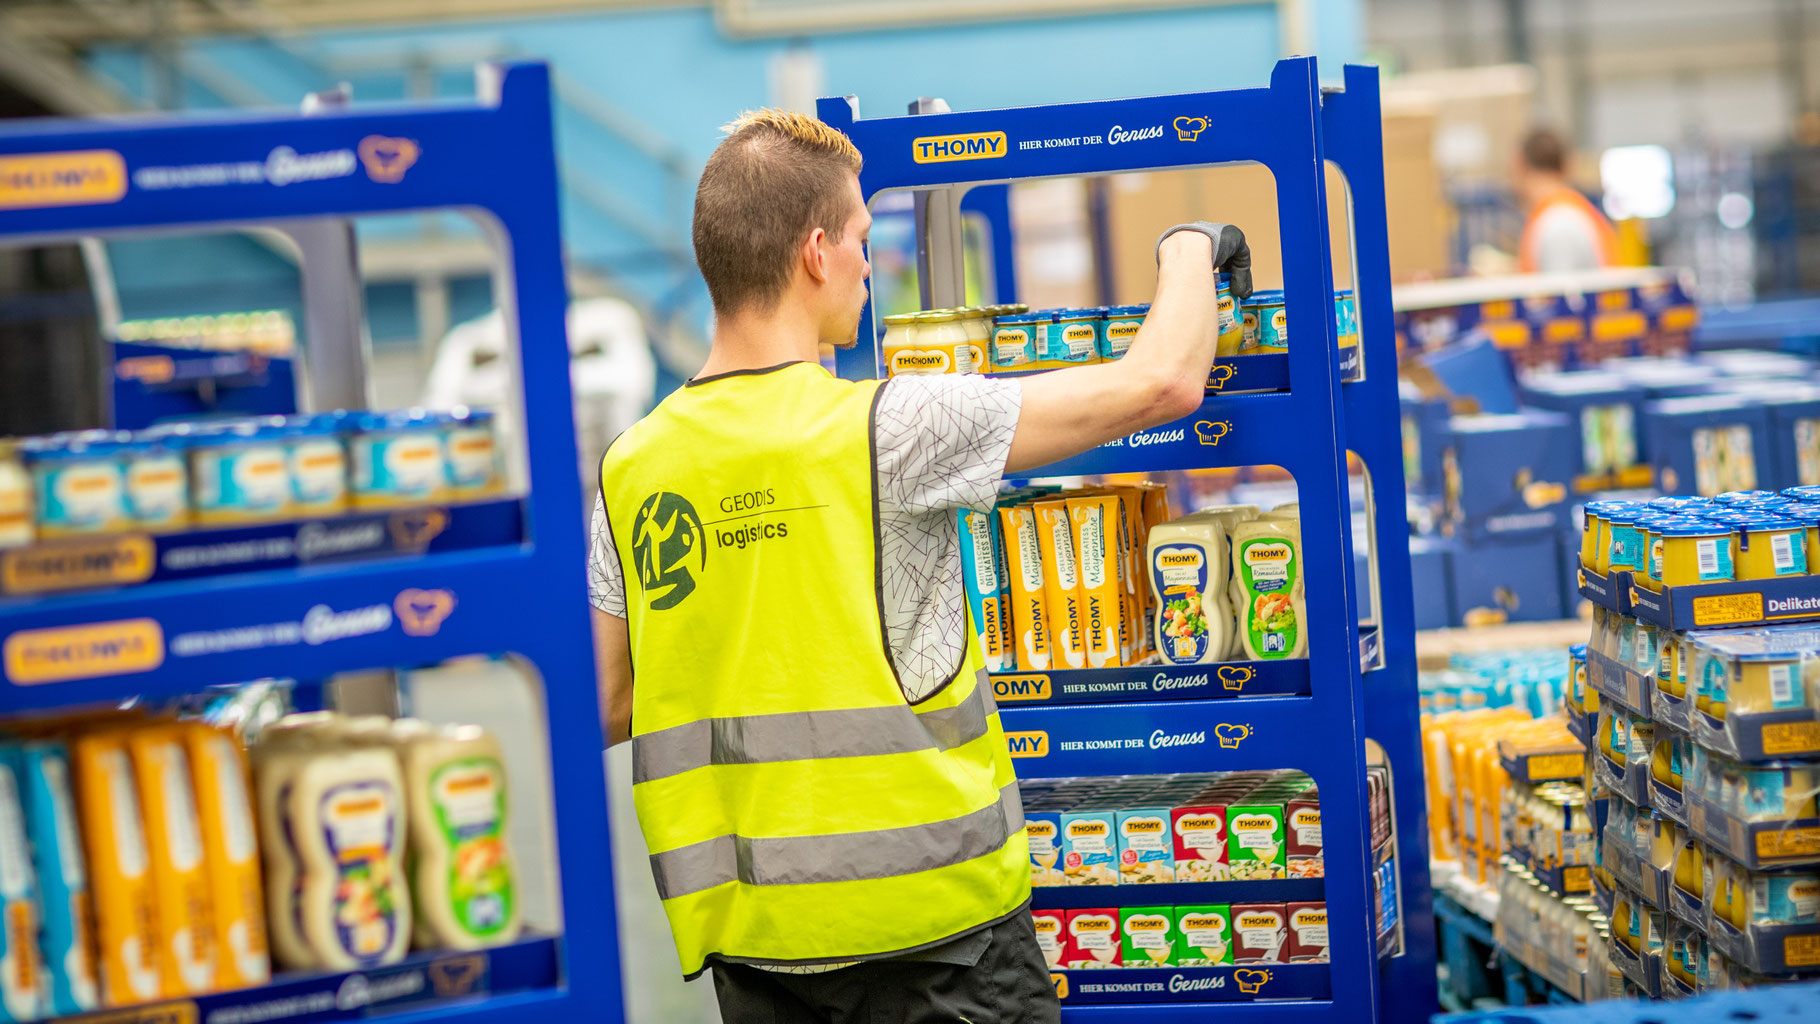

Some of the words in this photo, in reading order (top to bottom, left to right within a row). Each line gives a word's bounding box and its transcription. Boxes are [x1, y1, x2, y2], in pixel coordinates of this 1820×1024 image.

[917, 136, 1002, 158] THOMY
[1019, 139, 1043, 150] HIER
[1044, 137, 1081, 148] KOMMT
[1083, 136, 1103, 145] DER
[1107, 125, 1164, 146] Genuss
[1217, 300, 1232, 309] OMY
[1128, 428, 1185, 448] Genuss
[720, 488, 775, 513] GEODIS
[715, 520, 788, 549] logistics
[1021, 530, 1031, 574] DELIKATESS
[1026, 519, 1041, 586] Mayonnaise
[1055, 528, 1066, 572] DELIKATESS
[1060, 518, 1076, 583] Mayonnaise
[1082, 527, 1091, 571] DELIKATESS
[1090, 516, 1103, 583] Mayonnaise
[1163, 555, 1197, 563] THOMY
[1251, 550, 1285, 558] THOMY
[985, 602, 998, 655] THOMY
[1031, 598, 1044, 652] THOMY
[1067, 597, 1081, 650] THOMY
[1089, 596, 1102, 650] THOMY
[994, 679, 1045, 696] OMY
[1063, 684, 1087, 694] HIER
[1088, 682, 1125, 692] KOMMT
[1127, 681, 1147, 691] DER
[1152, 672, 1208, 692] Genuss
[1060, 741, 1084, 751] HIER
[1085, 739, 1123, 750] KOMMT
[1125, 738, 1145, 749] DER
[1149, 729, 1206, 750] Genuss
[1128, 822, 1160, 830] THOMY
[1035, 921, 1055, 929] OMY
[1076, 920, 1109, 928] THOMY
[1131, 920, 1164, 928] THOMY
[1079, 984, 1104, 993] HIER
[1105, 983, 1142, 992] KOMMT
[1143, 983, 1165, 991] DER
[1168, 974, 1225, 993] Genuss
